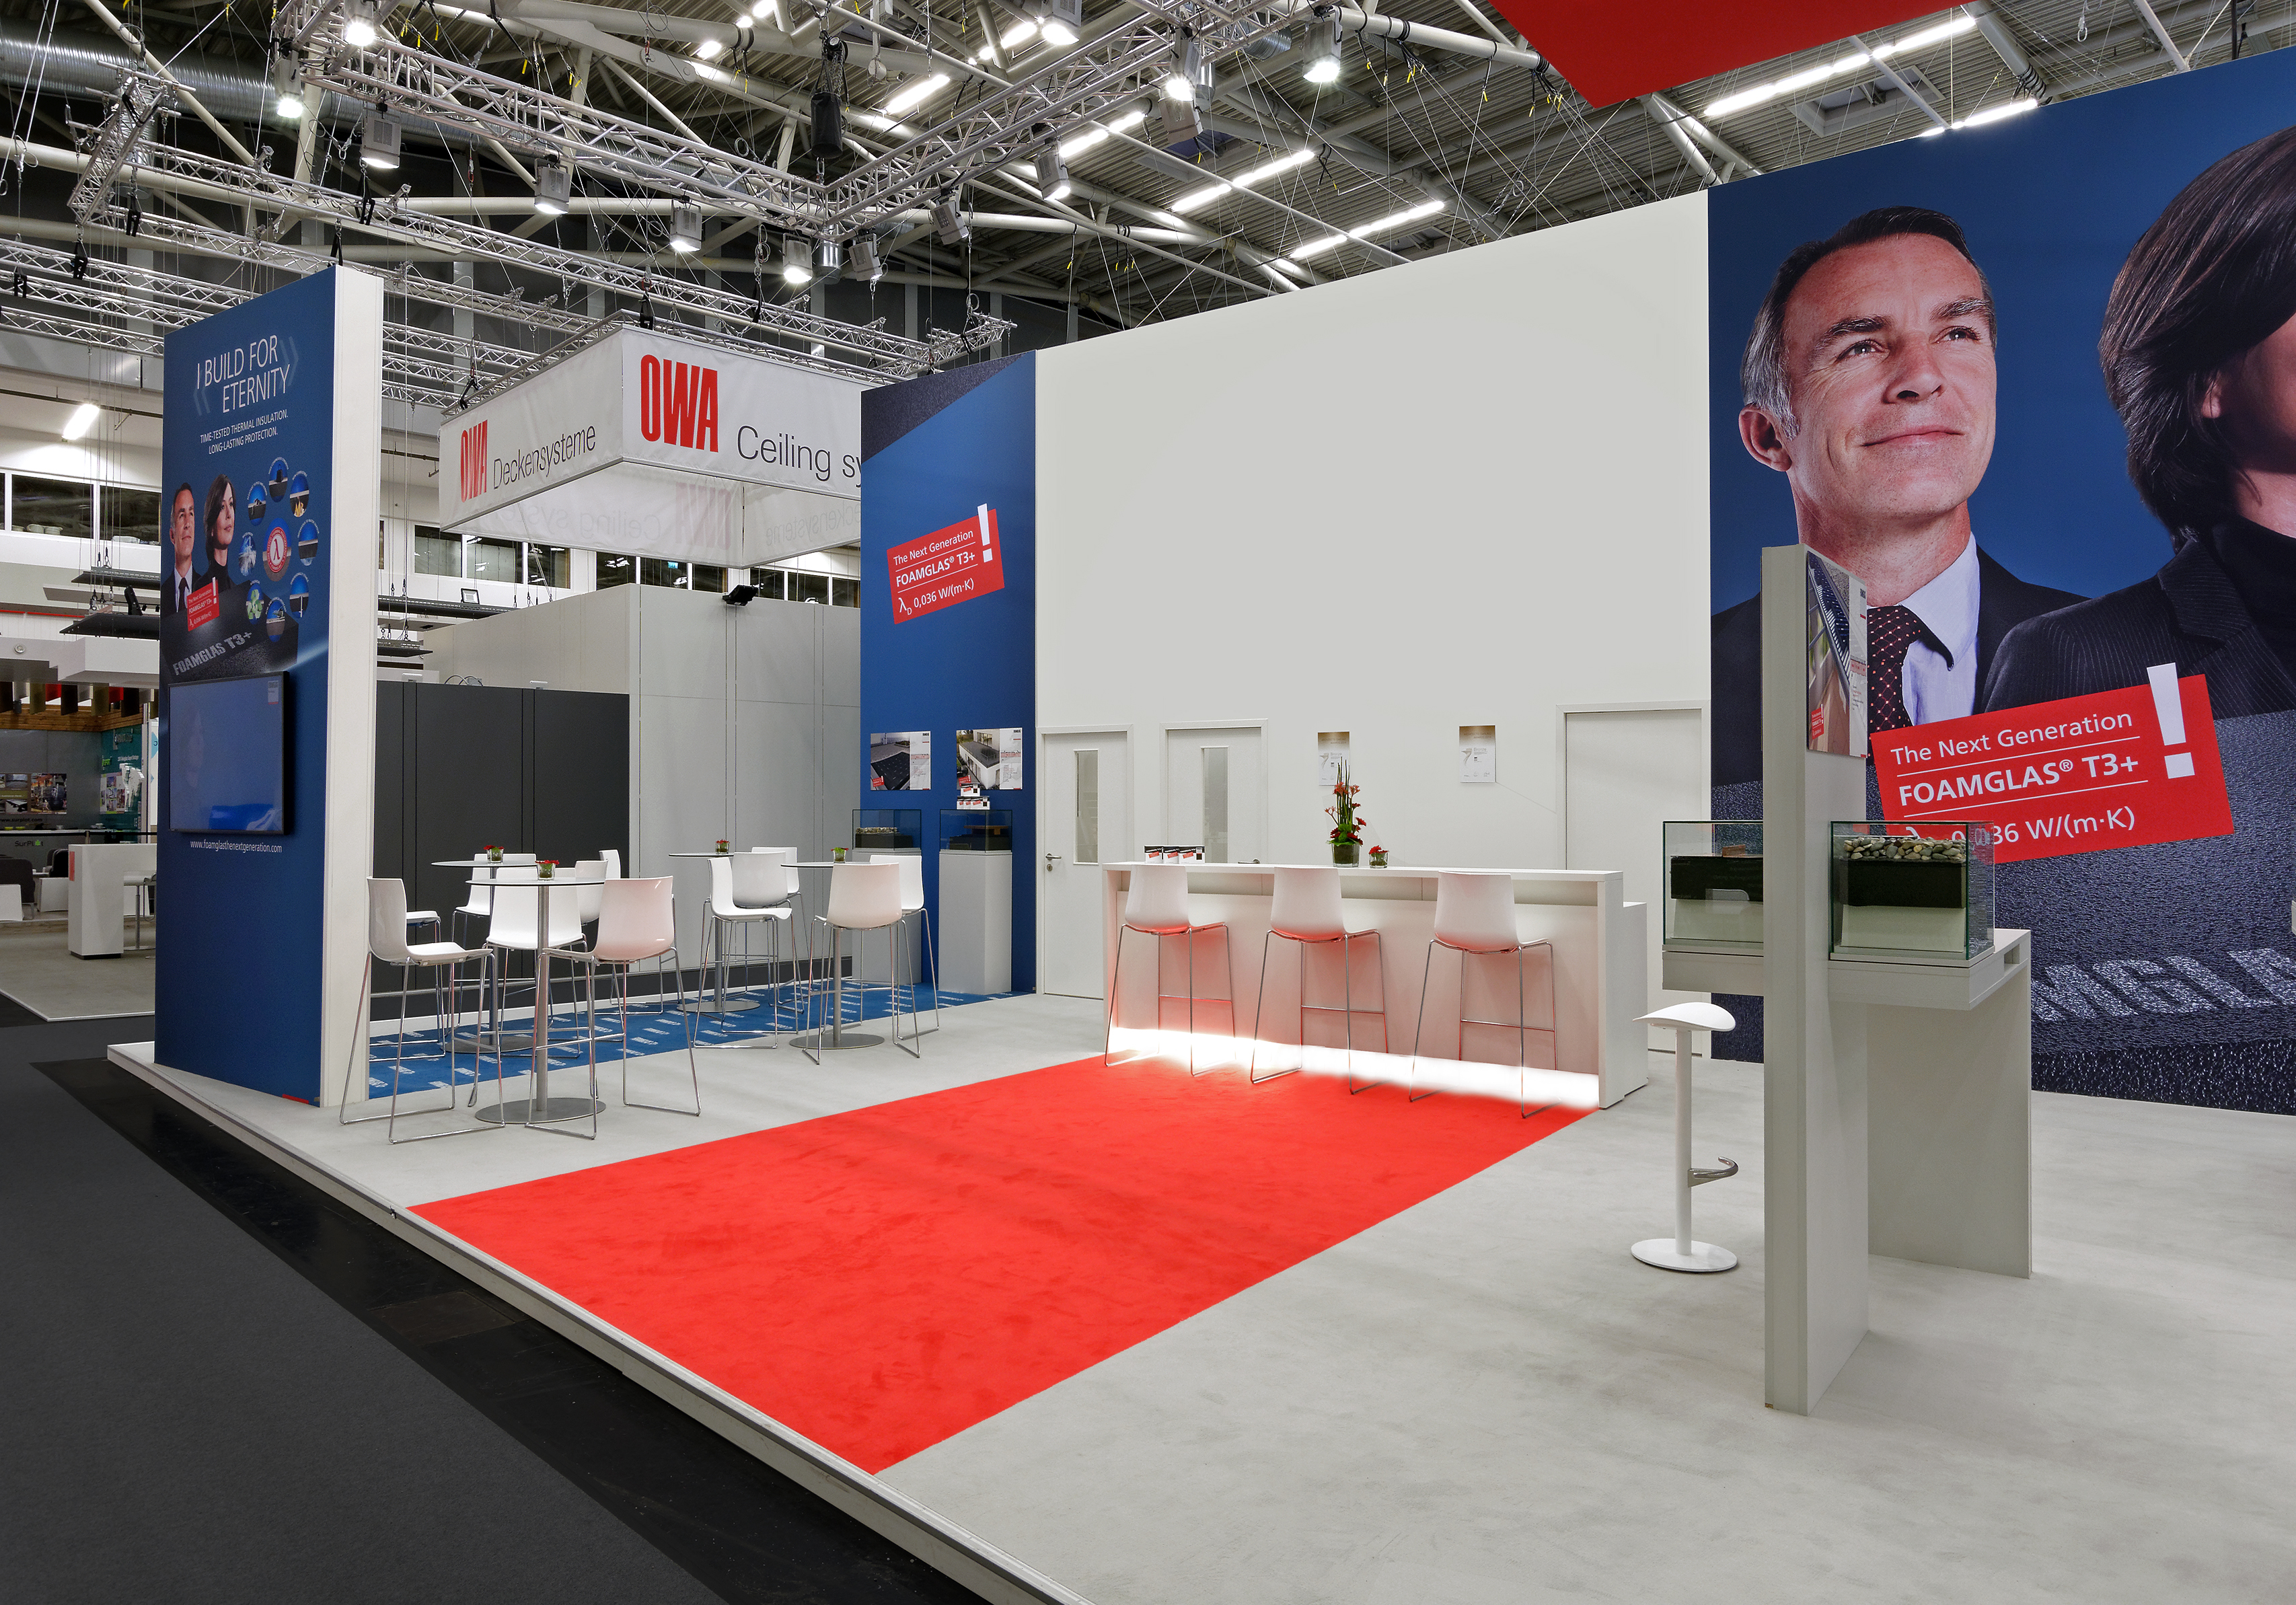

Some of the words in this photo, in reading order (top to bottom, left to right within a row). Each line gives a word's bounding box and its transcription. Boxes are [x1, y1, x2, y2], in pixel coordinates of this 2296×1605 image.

[196, 363, 200, 389] I
[205, 348, 244, 387] BUILD
[250, 334, 278, 371] FOR
[223, 364, 290, 413] ETERNITY
[200, 426, 230, 443] TIME-TESTED
[231, 419, 255, 434] THERMAL
[256, 409, 289, 427] INSULATION.
[640, 354, 718, 453] OWA
[737, 425, 830, 482] Ceiling
[842, 454, 861, 488] sy
[209, 436, 244, 455] LONG-LASTING
[245, 426, 278, 444] PROTECTION.
[460, 419, 488, 502] OWA
[494, 426, 595, 490] Deckensysteme
[893, 555, 908, 566] The
[910, 546, 927, 560] Next
[929, 530, 973, 553] Generation
[956, 550, 975, 565] T3+
[914, 591, 937, 609] 0,036
[172, 642, 226, 675] FOAMGLAS
[224, 632, 252, 649] T3+
[1890, 745, 1932, 765] The
[1938, 735, 1991, 757] Next
[1997, 713, 2133, 747] Generation
[2081, 753, 2139, 778] T3+
[190, 839, 283, 853] www.foamglasthenextgeneration.com
